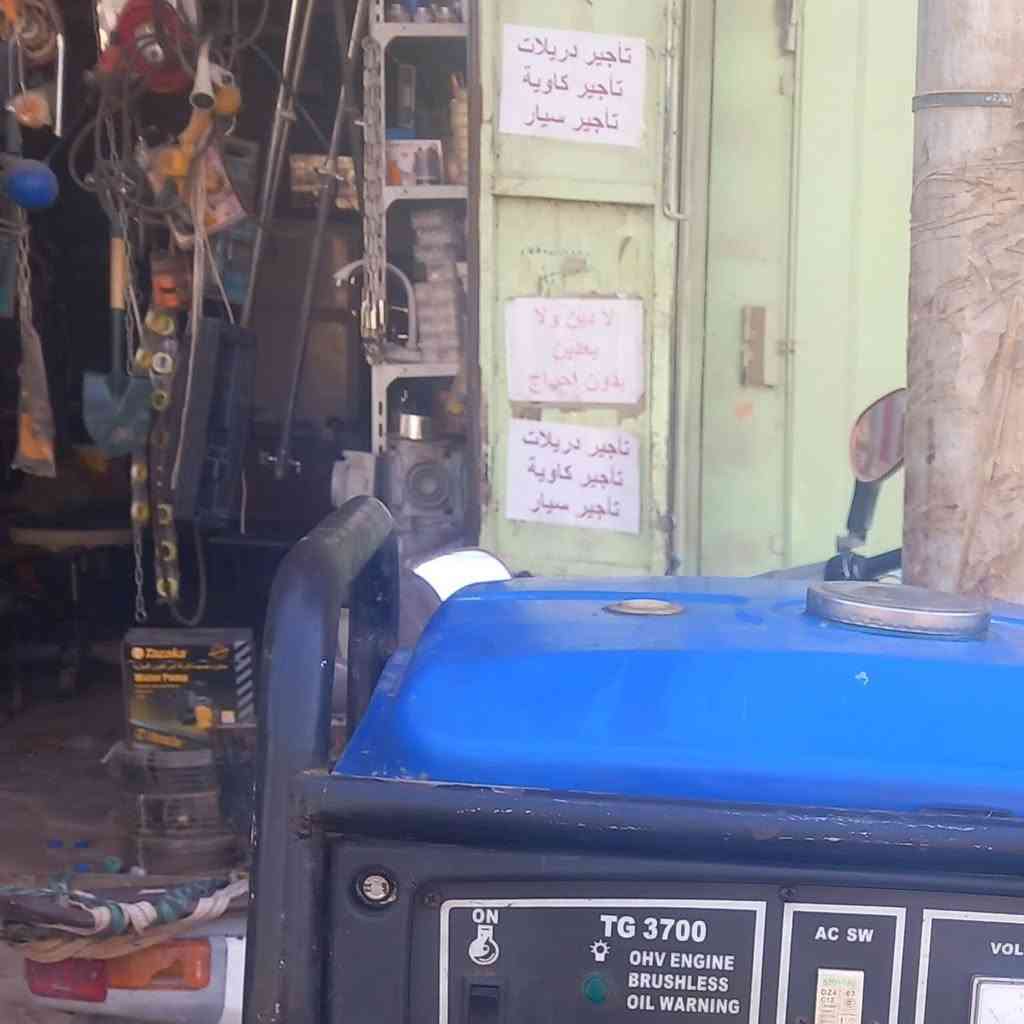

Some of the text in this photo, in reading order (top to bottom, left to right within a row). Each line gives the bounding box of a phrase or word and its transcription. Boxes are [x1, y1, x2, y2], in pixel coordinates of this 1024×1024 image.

[517, 36, 578, 63] دريلات
[521, 65, 569, 95] كاوية
[523, 103, 565, 128] سيار
[522, 429, 581, 455] دريلات
[527, 455, 573, 485] كاوية
[528, 492, 569, 514] سيار
[472, 908, 499, 924] ON
[600, 915, 707, 942] TG 3700
[815, 926, 873, 942] AC SW
[629, 950, 735, 970] OHV ENGINE
[628, 973, 729, 991] BRUSHLESS
[627, 995, 740, 1014] OIL WARNING
